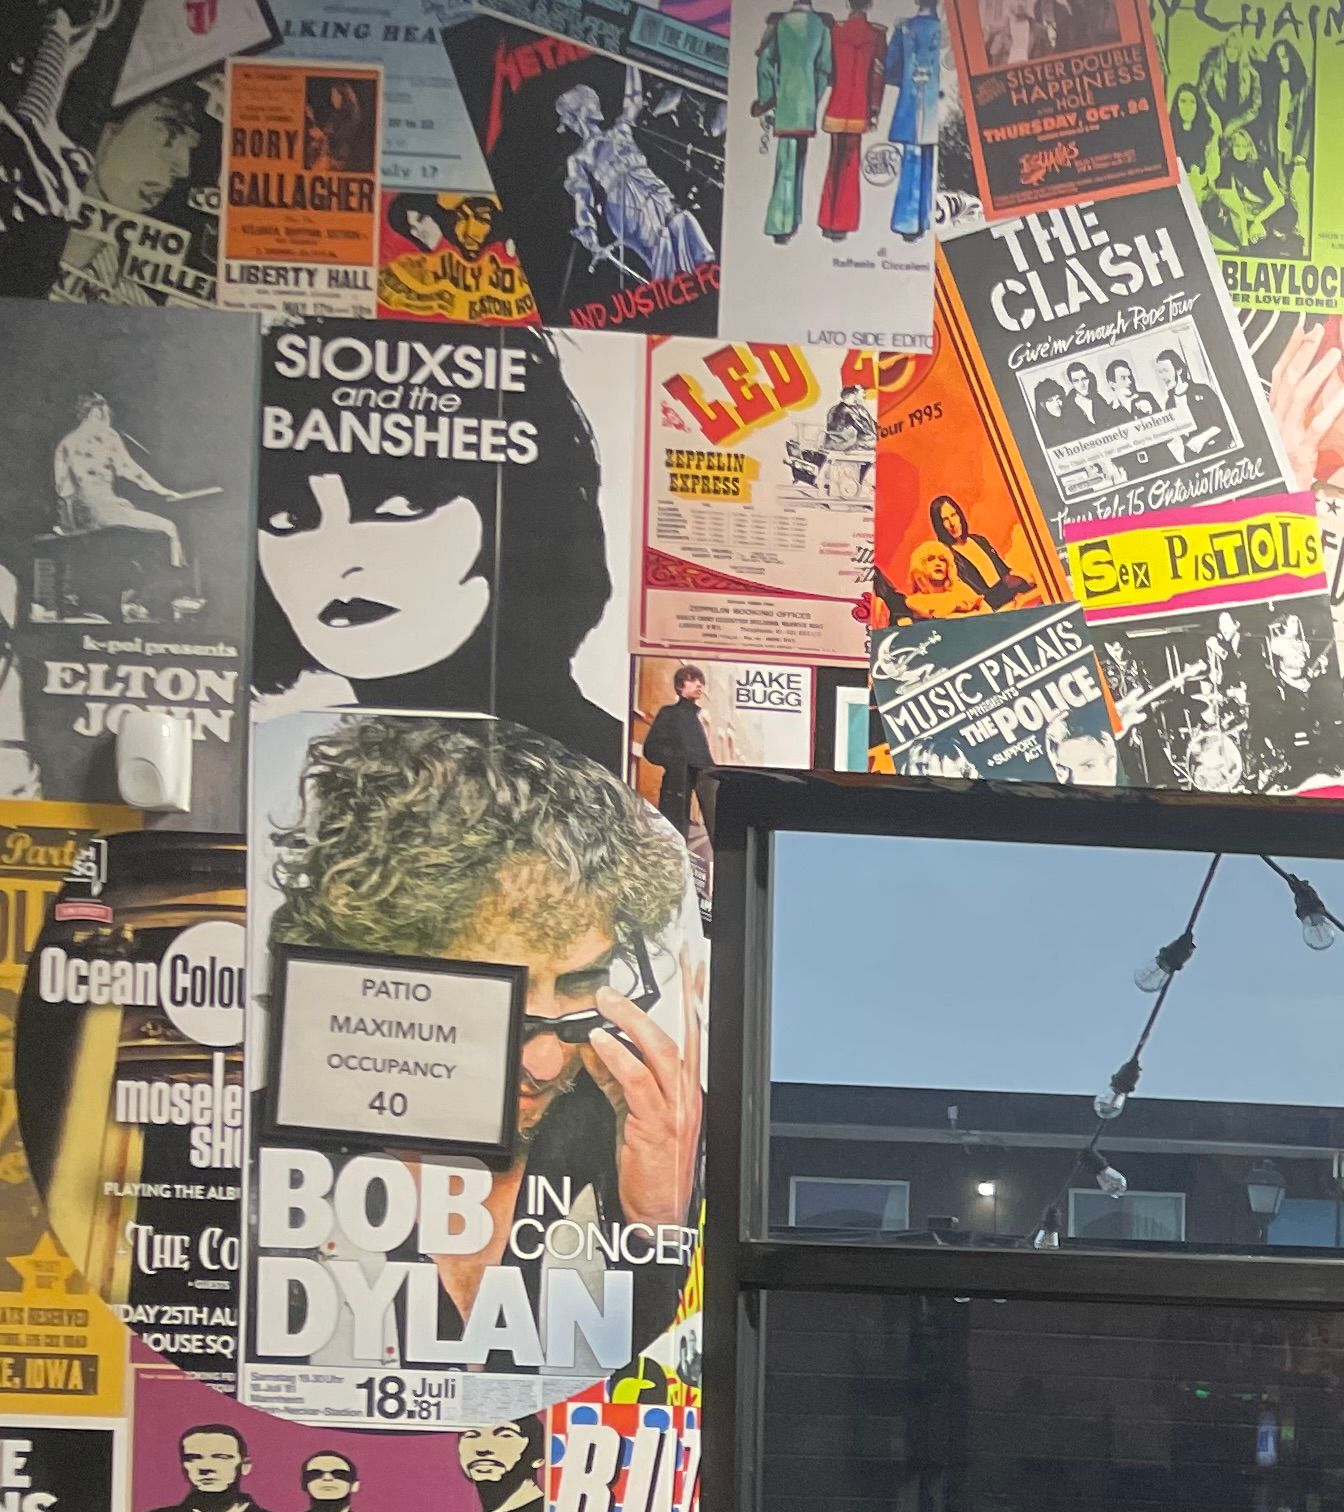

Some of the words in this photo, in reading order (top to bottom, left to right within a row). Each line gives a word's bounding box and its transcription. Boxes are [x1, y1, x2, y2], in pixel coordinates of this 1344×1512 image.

[232, 128, 297, 160] RORY
[228, 172, 374, 213] GALLAGHER
[992, 201, 1111, 273] THE
[225, 265, 317, 287] LIBERTY
[326, 269, 372, 291] HALL
[990, 228, 1185, 332] CLASH
[274, 335, 528, 393] SIOUXSIE
[332, 386, 397, 410] and
[408, 387, 462, 413] the
[662, 342, 811, 445] LED
[261, 406, 540, 465] BANSHEES
[1052, 428, 1130, 461] Wholesomely
[1133, 412, 1175, 433] violent
[664, 447, 745, 473] ZEPPELIN
[668, 473, 740, 496] EXPRESS
[42, 660, 238, 704] ELTON
[735, 687, 802, 708] BUGG
[736, 669, 802, 691] JAKE
[884, 669, 976, 742] MUSIC
[979, 619, 1083, 694] PALAIS
[959, 716, 998, 747] THE
[1000, 664, 1100, 742] POLICE
[38, 946, 159, 1007] Ocean
[361, 977, 433, 1002] PATIO
[328, 1014, 458, 1045] MAXIMUM
[326, 1053, 457, 1081] OCCUPANCY
[367, 1092, 408, 1118] 40
[257, 1147, 495, 1256] BOB
[526, 1174, 572, 1217] IN
[257, 1256, 634, 1368] DYLAN
[25, 1361, 83, 1392] IOWA
